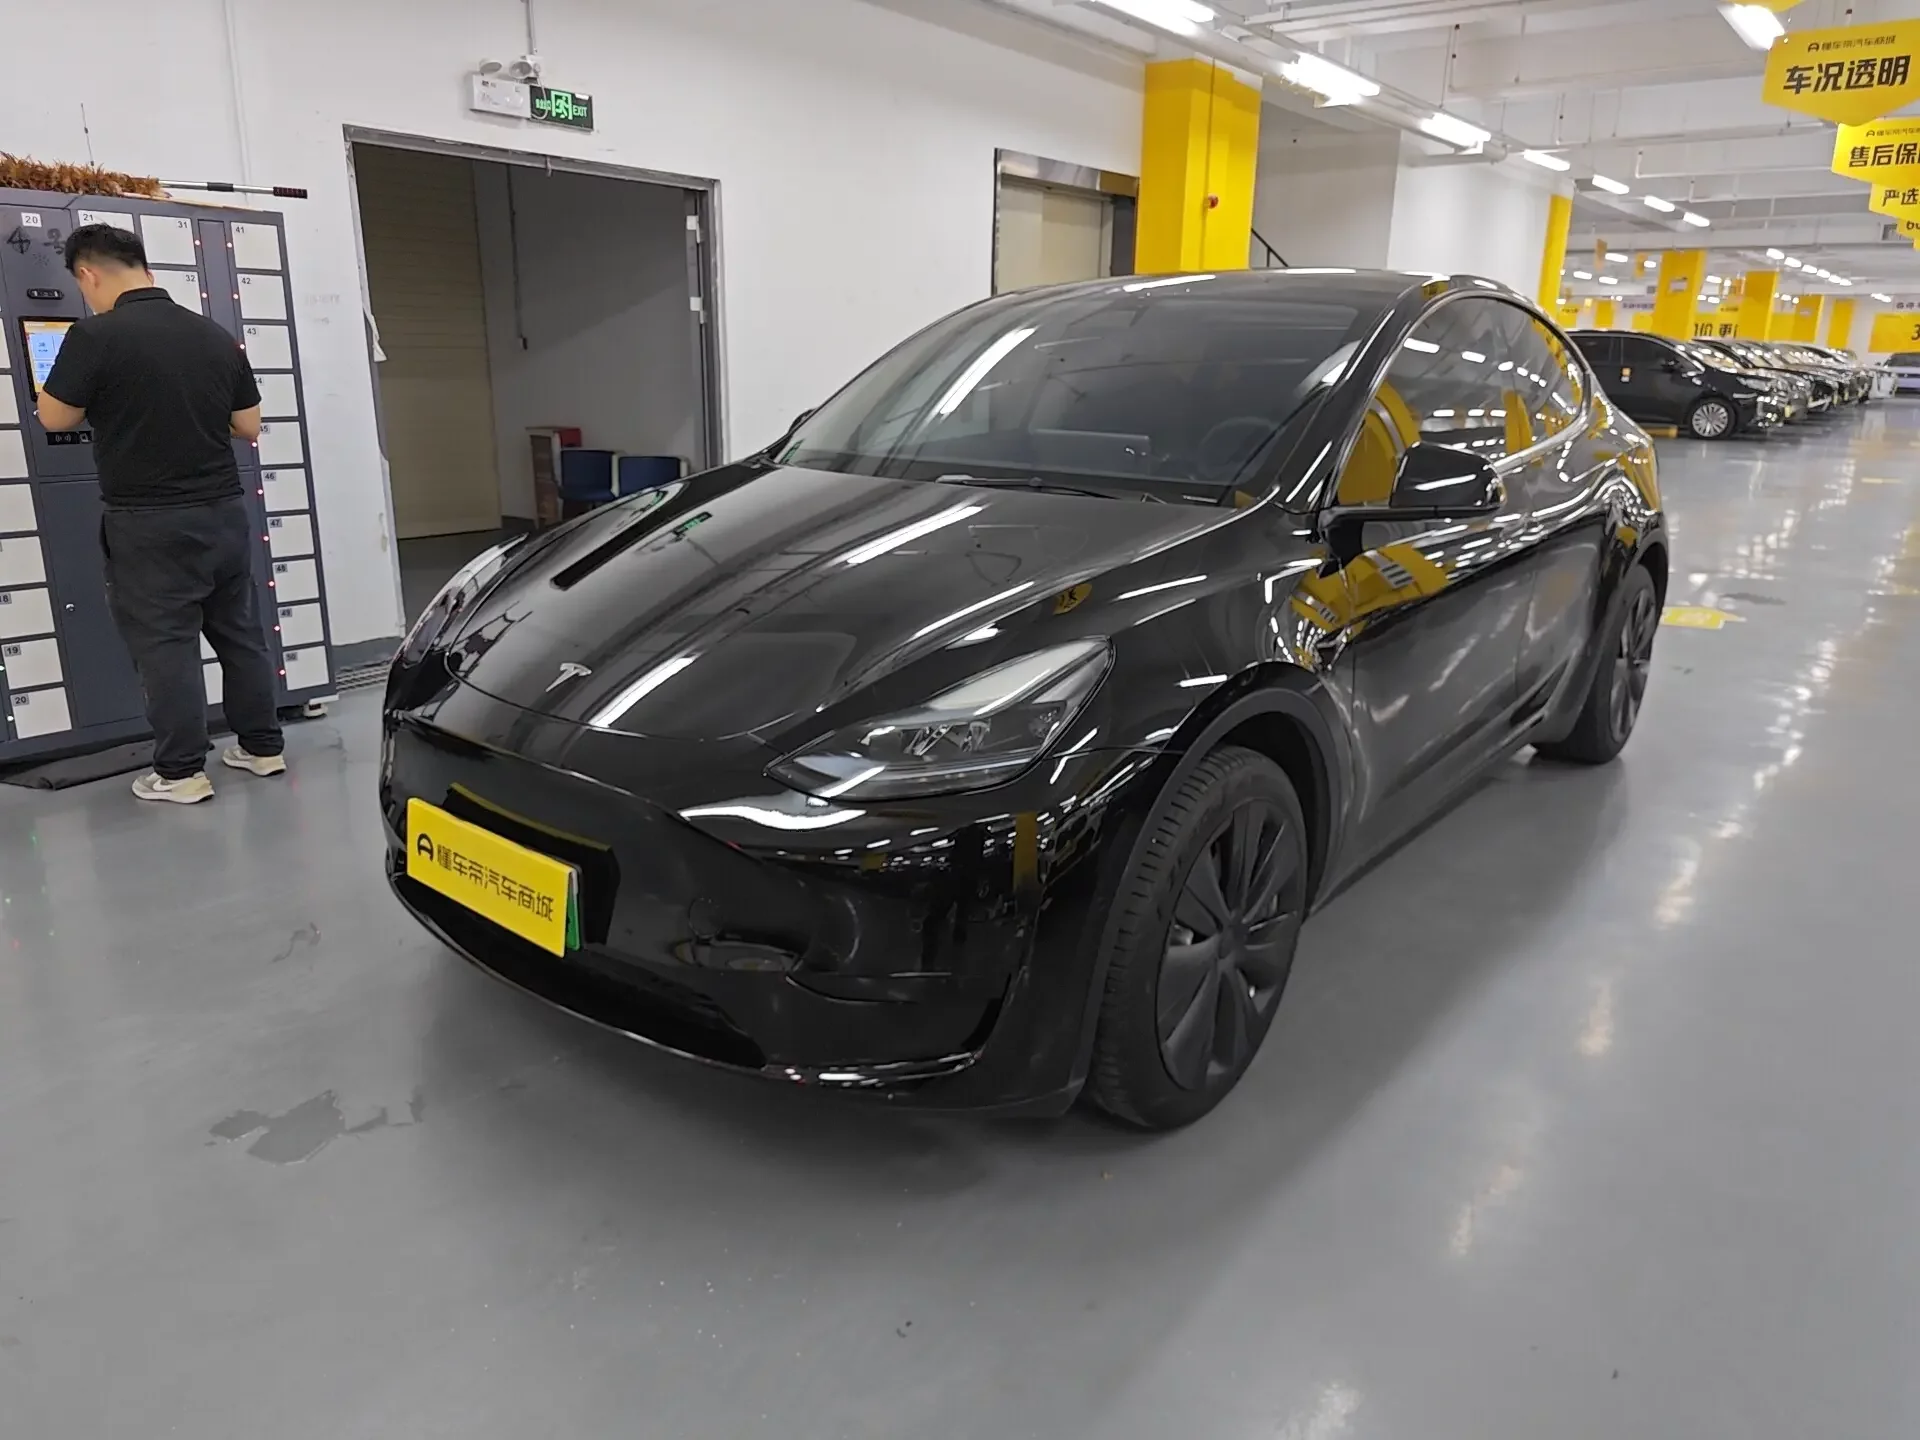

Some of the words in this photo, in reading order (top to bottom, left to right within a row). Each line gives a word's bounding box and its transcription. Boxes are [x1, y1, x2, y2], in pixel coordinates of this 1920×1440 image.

[1783, 55, 1912, 95] 车况透明
[572, 104, 588, 118] EXIT
[1849, 143, 1920, 167] 售后保
[1882, 188, 1920, 207] 严选
[25, 215, 38, 224] 20
[83, 213, 94, 222] 21
[178, 220, 188, 229] 31
[235, 226, 245, 234] 41
[185, 274, 196, 282] 32
[241, 277, 251, 285] 42
[246, 327, 257, 335] 43
[264, 472, 275, 480] 46
[270, 519, 280, 527] 47
[6, 646, 19, 655] 19
[15, 696, 27, 705] 20
[437, 844, 554, 922] 懂车帝汽车商城
